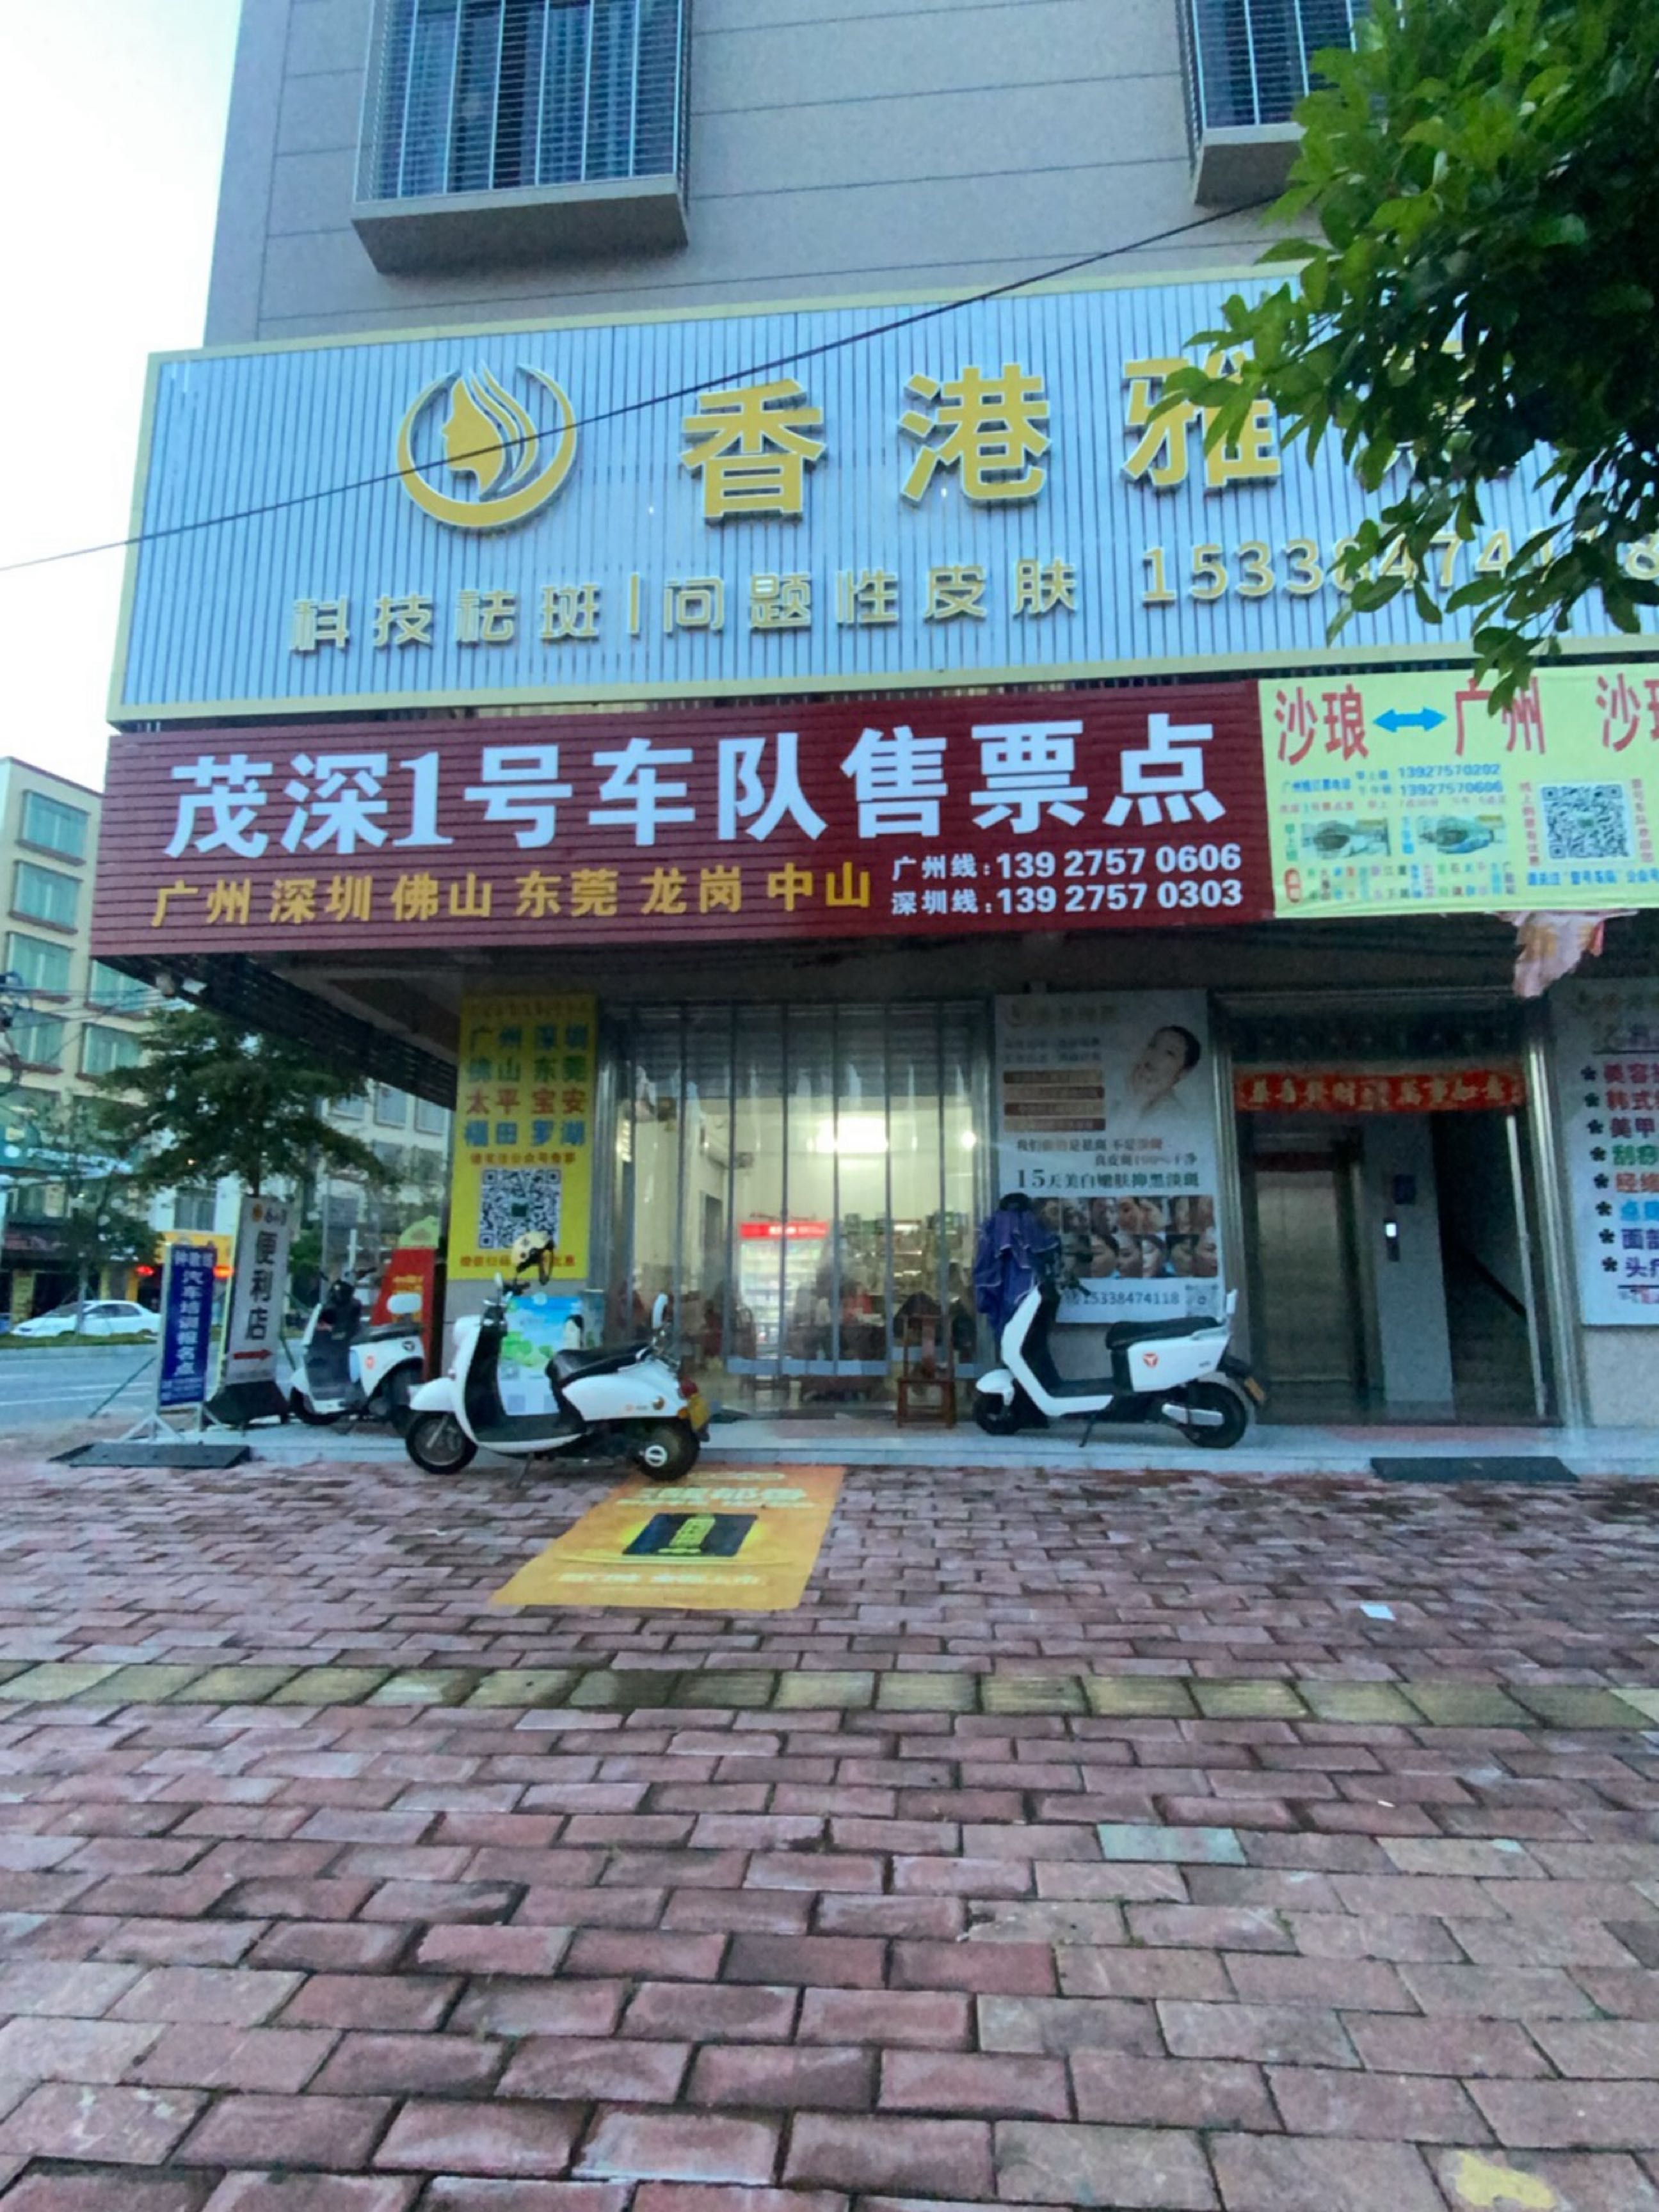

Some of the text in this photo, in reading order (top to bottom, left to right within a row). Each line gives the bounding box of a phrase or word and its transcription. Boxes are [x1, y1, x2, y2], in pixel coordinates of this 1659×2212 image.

[1274, 673, 1659, 765] 沙琅 广州 沙
[164, 712, 1228, 859] 茂深1号车队售票点
[152, 861, 870, 927] 广州 深圳 佛山 东莞 龙岗 中山
[465, 1089, 586, 1115] 太平 宝安
[1606, 1089, 1659, 1111] 韩式
[245, 1231, 278, 1341] 便利店
